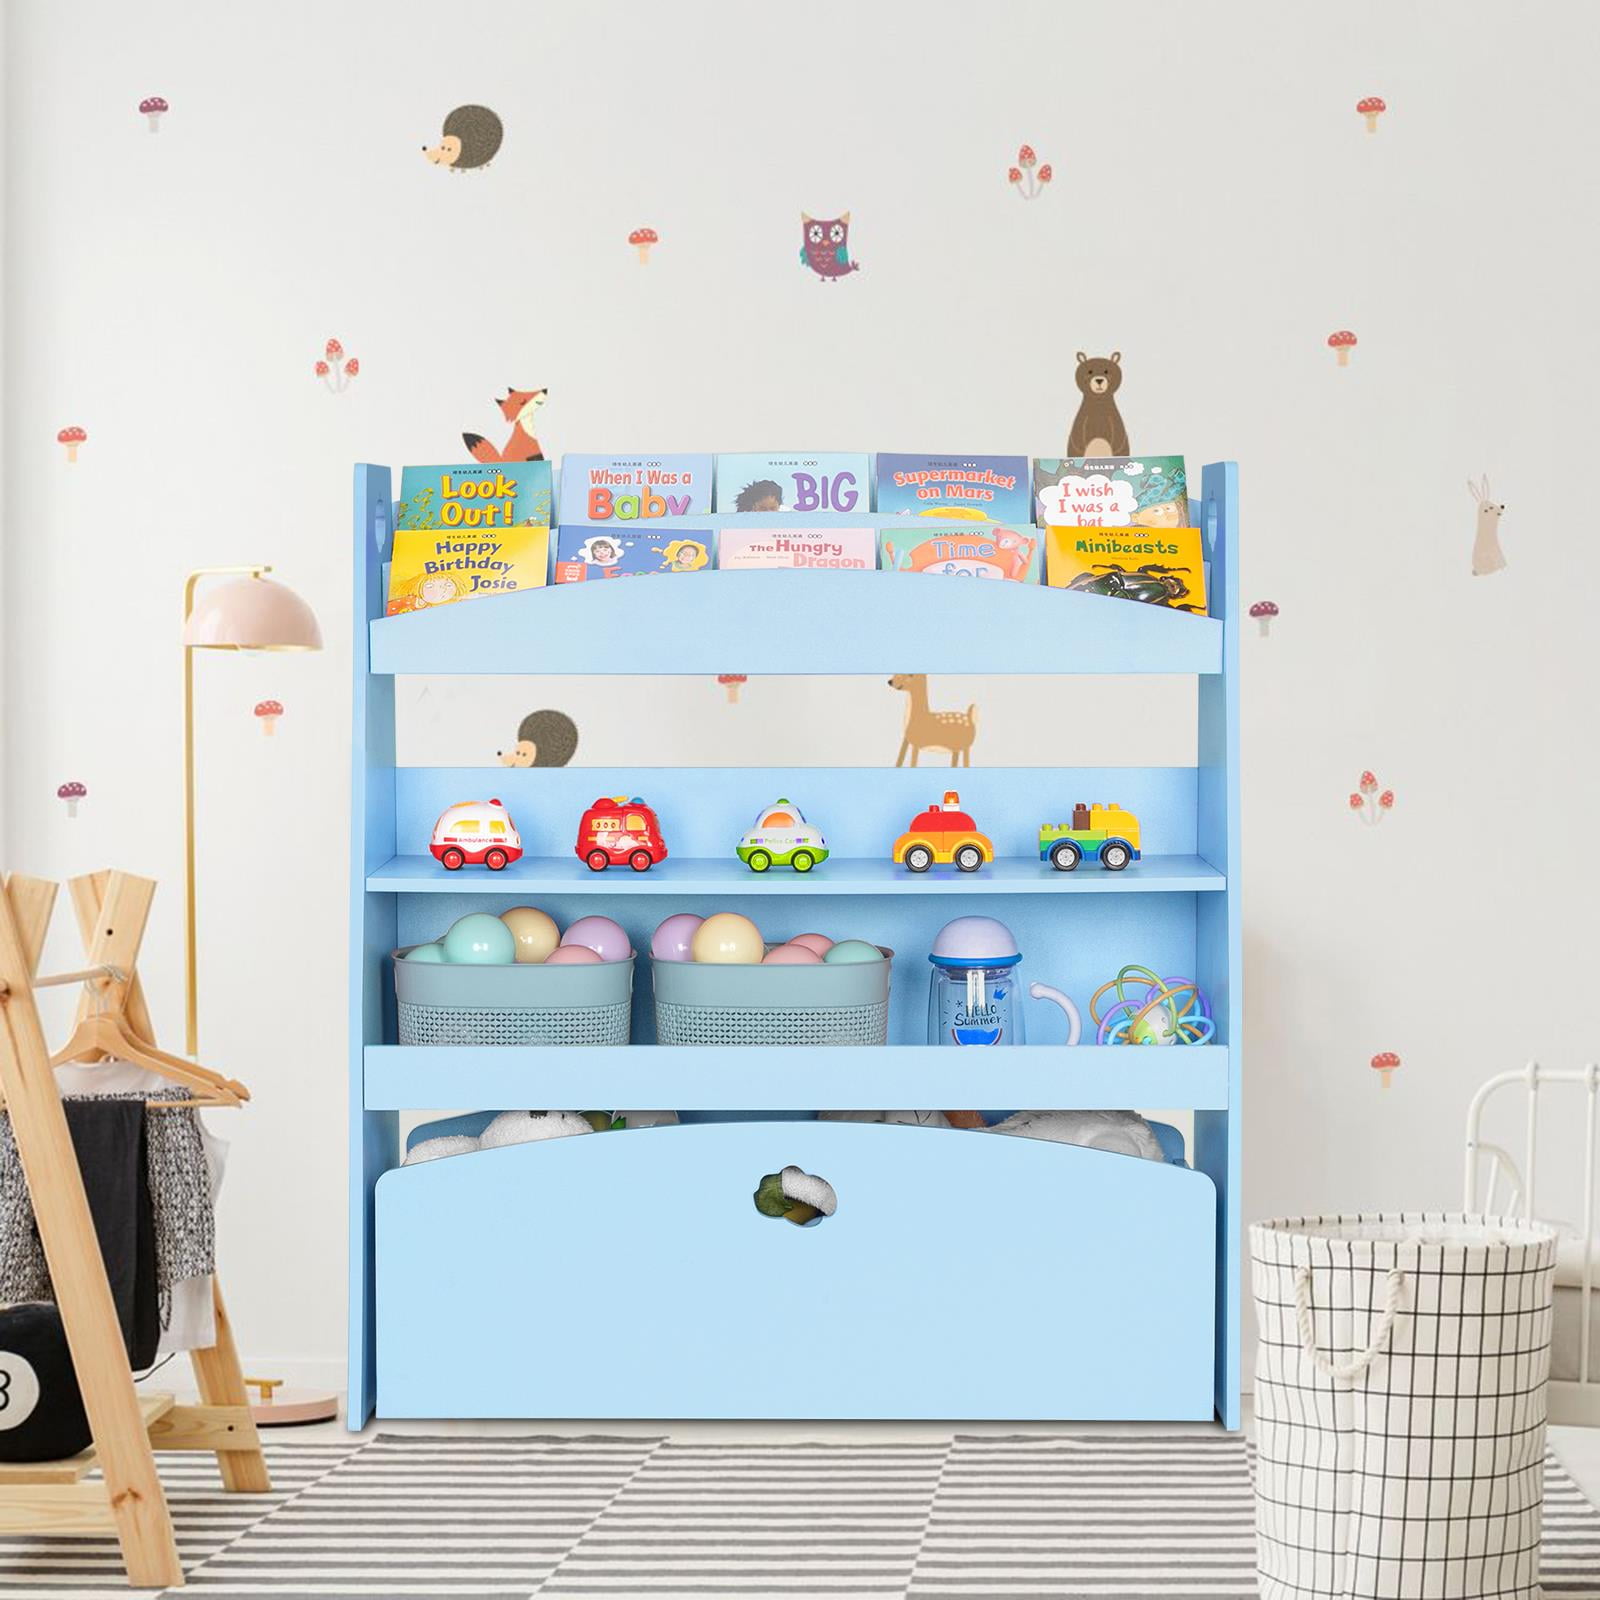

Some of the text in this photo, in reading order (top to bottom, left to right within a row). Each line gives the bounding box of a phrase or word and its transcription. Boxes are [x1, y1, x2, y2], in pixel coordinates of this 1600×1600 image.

[589, 469, 691, 485] When I Was a
[894, 469, 1016, 490] Supermarket
[441, 474, 518, 500] Look
[791, 471, 859, 512] BIG
[917, 484, 994, 501] on Mars
[1062, 482, 1114, 497] I wish
[588, 485, 691, 520] Baby
[1058, 498, 1120, 513] I was a
[440, 500, 514, 526] Out!
[1077, 514, 1104, 527] bat
[435, 540, 503, 556] Happy
[749, 539, 843, 556] The Hungry
[932, 541, 994, 559] Time
[1075, 538, 1179, 554] Minibeasts
[424, 557, 515, 575] Birthday
[793, 553, 865, 569] Dragon
[469, 575, 518, 592] Josie
[954, 1012, 1002, 1026] Summer
